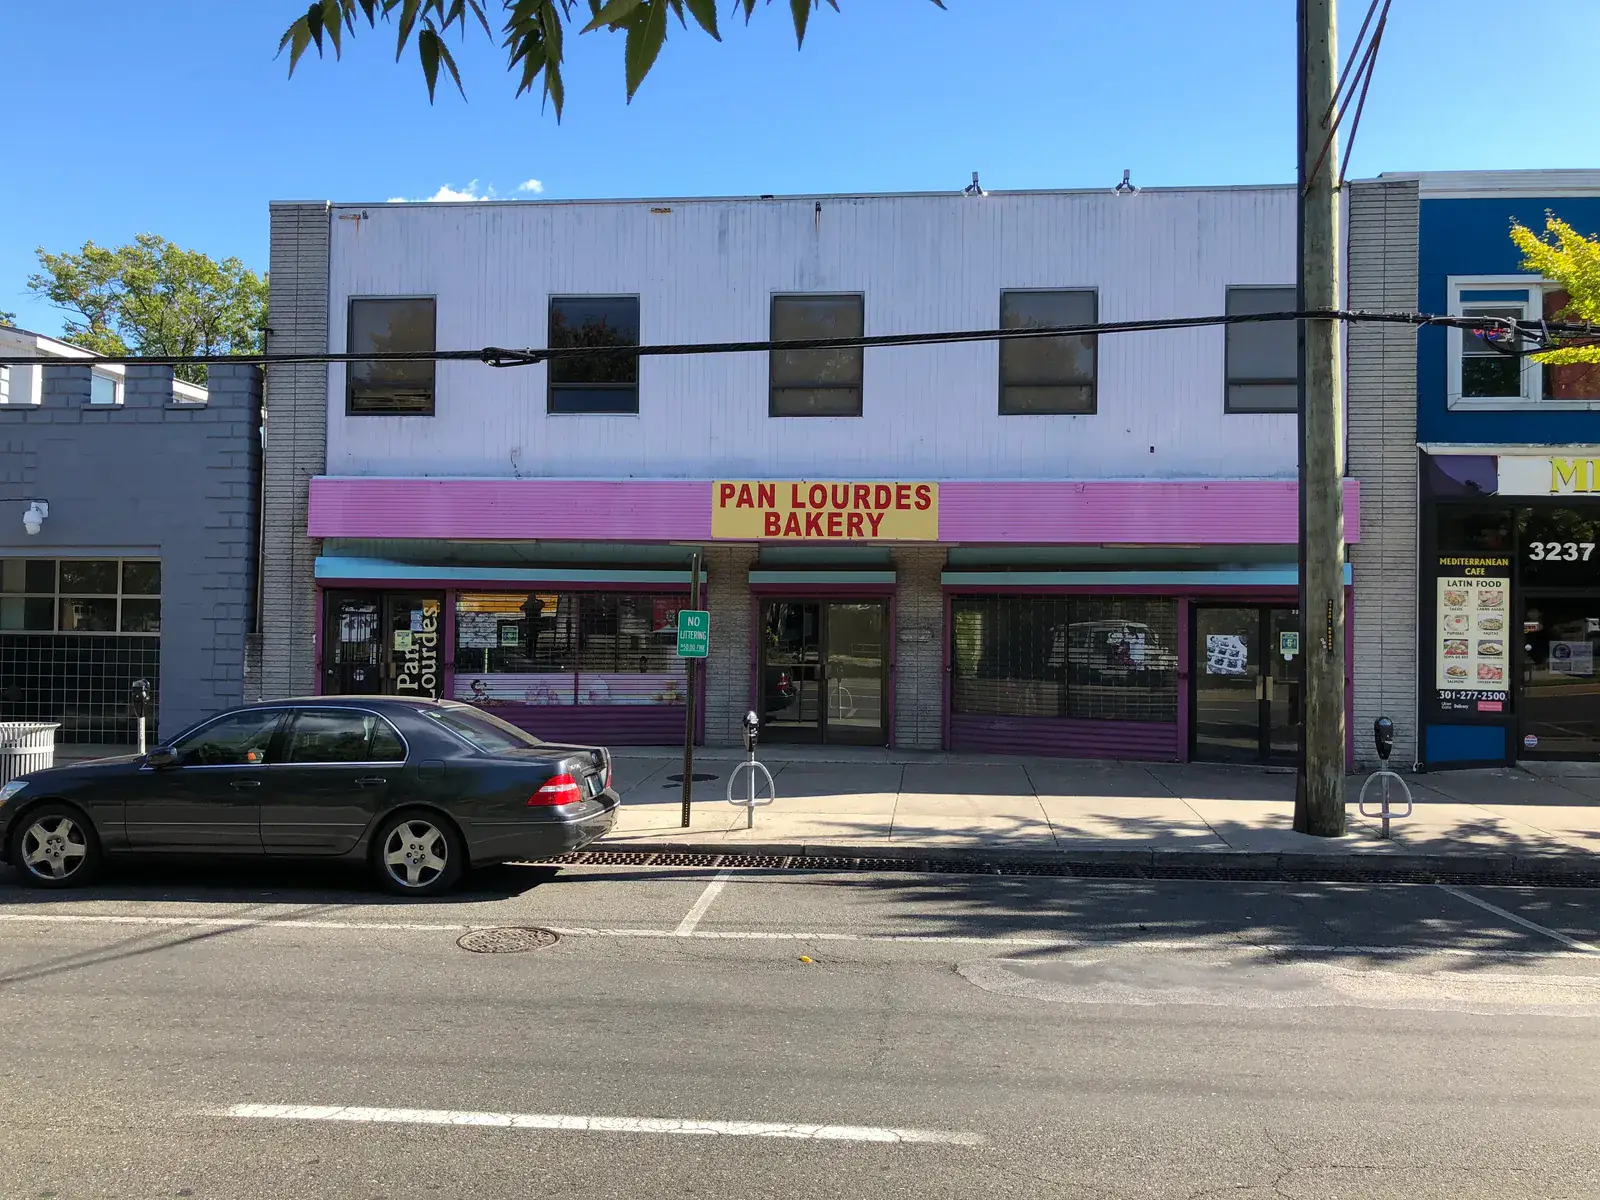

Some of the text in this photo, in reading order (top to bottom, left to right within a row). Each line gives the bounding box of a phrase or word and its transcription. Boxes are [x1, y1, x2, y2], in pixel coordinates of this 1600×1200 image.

[720, 484, 932, 511] PAN LOURDES
[764, 511, 885, 537] BAKERY
[1529, 542, 1595, 561] 3237
[1439, 557, 1509, 566] MEDITERRANEAN
[1464, 567, 1486, 576] CAFE
[1447, 580, 1502, 588] LATIN FOOD
[687, 616, 701, 627] NO
[680, 630, 707, 640] LITTERING
[397, 644, 420, 690] Pan
[1439, 691, 1506, 700] 301-277-2500
